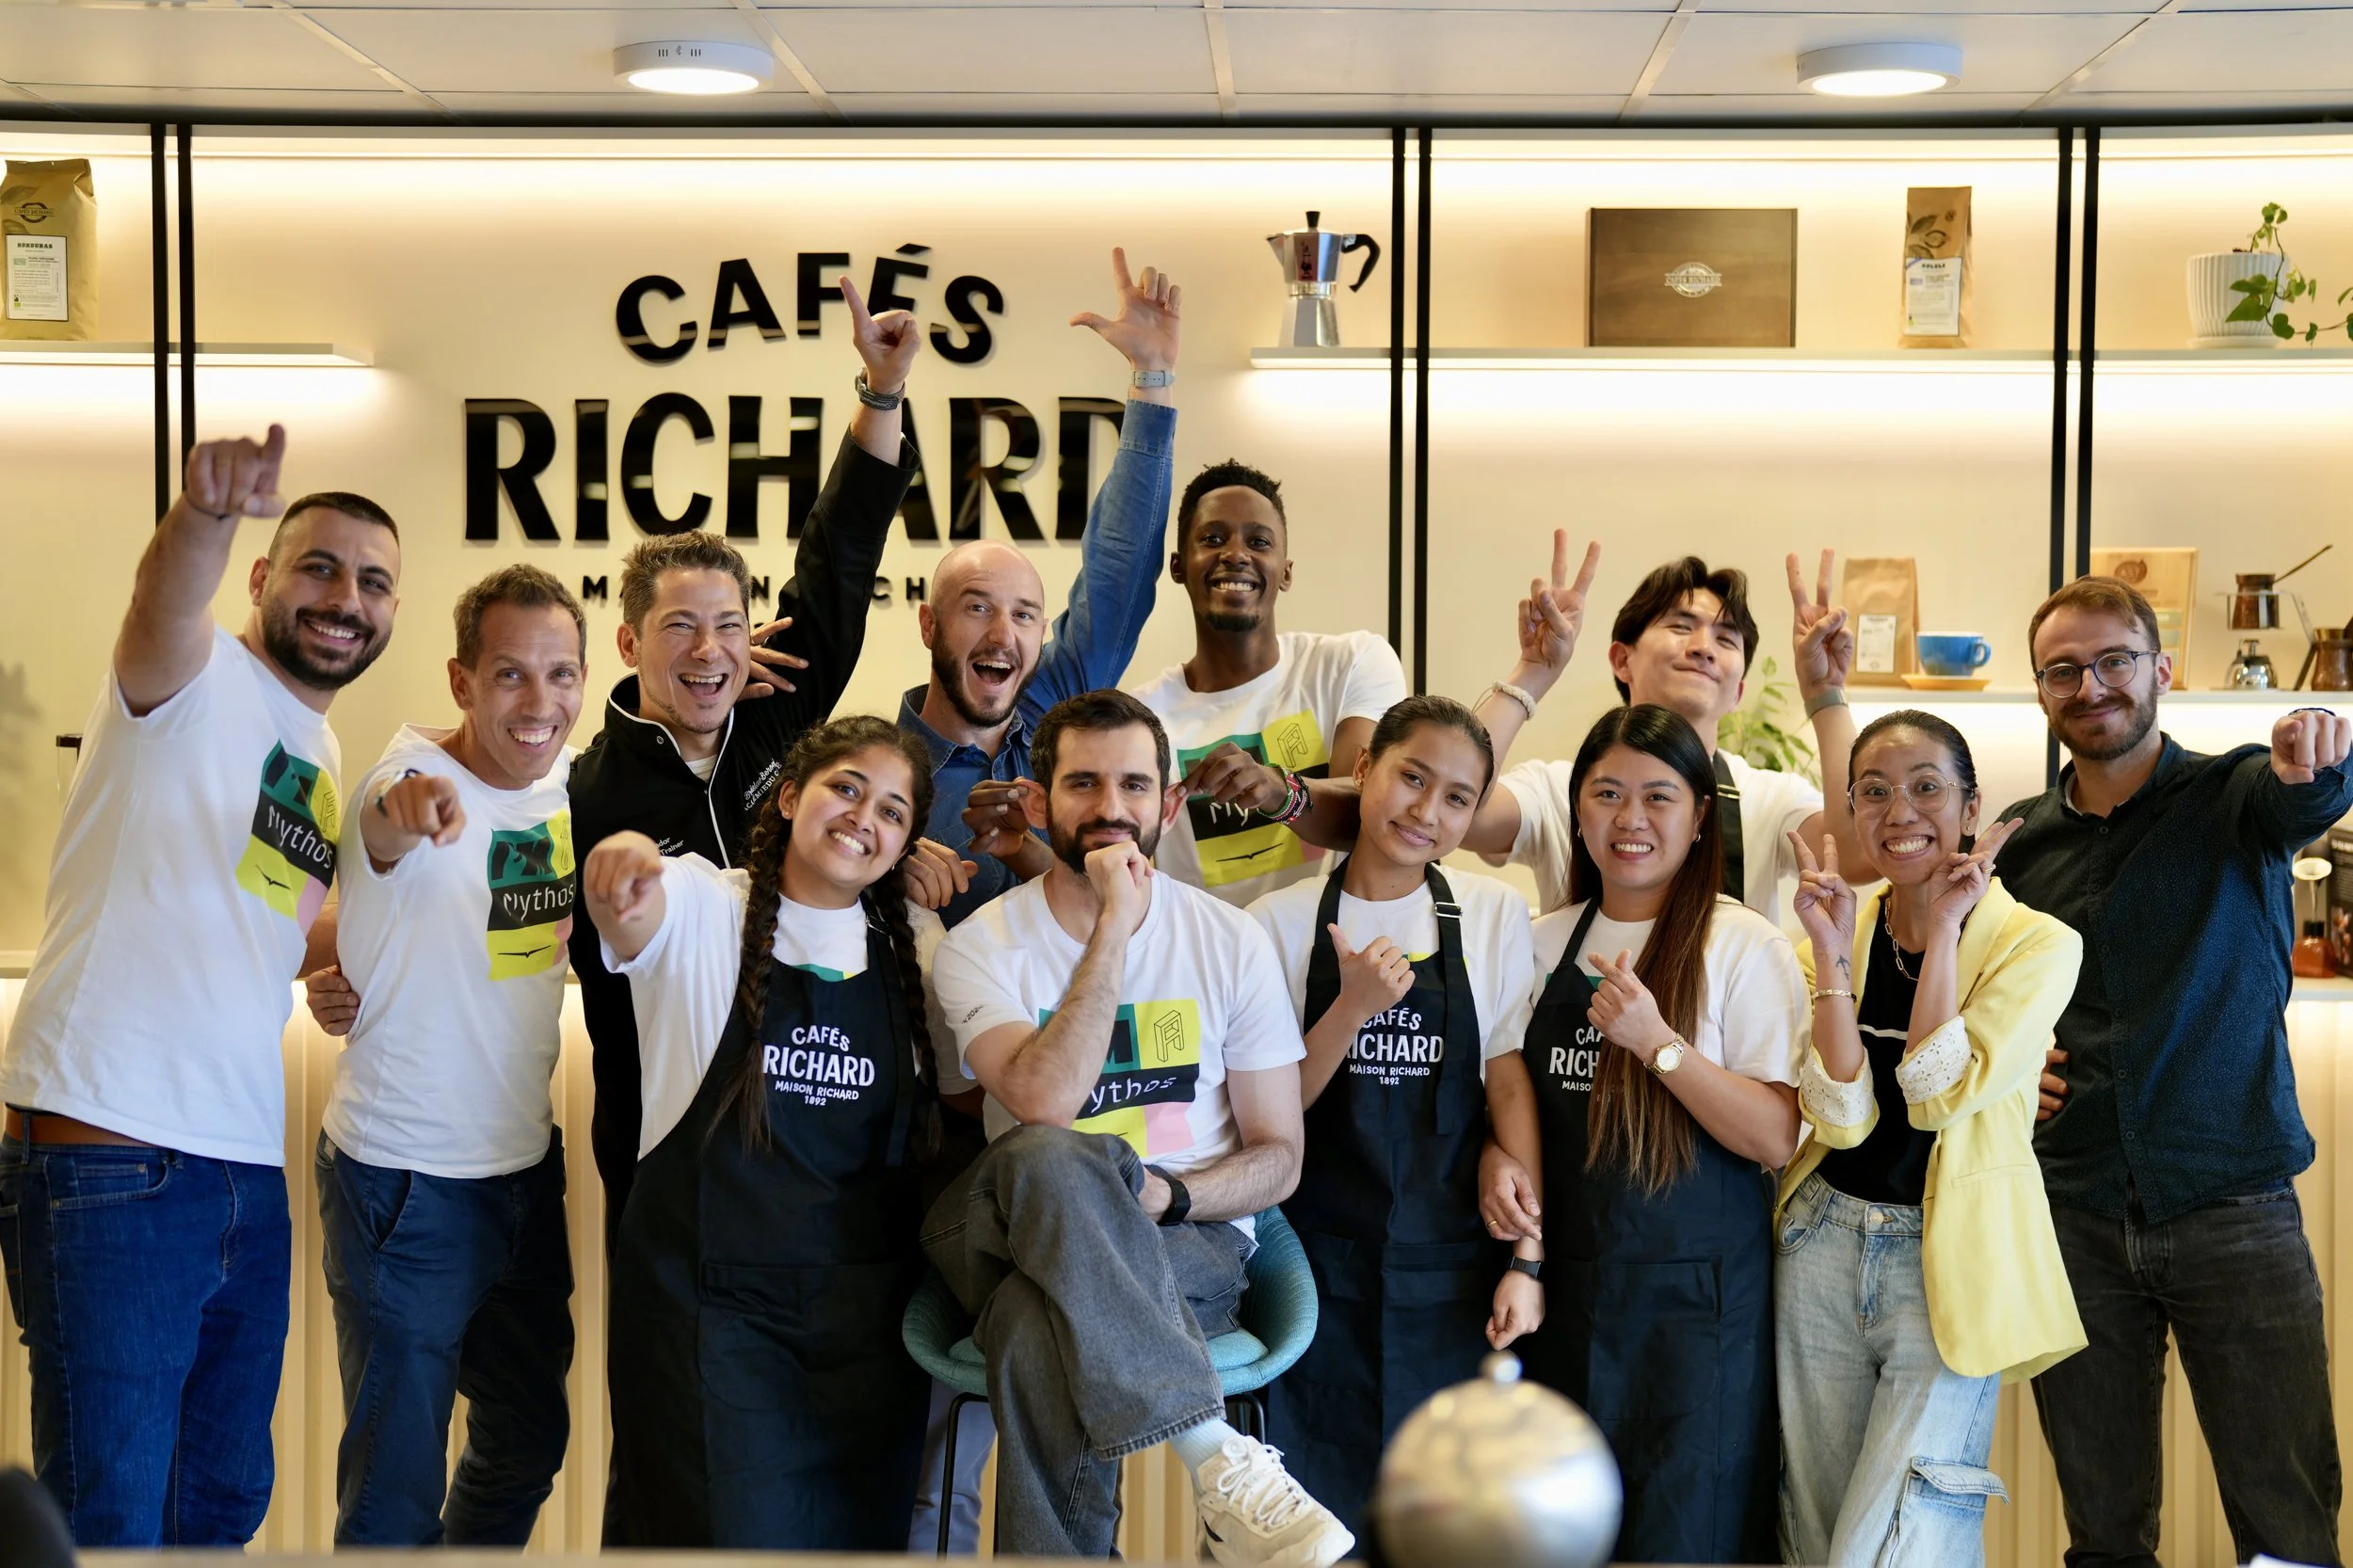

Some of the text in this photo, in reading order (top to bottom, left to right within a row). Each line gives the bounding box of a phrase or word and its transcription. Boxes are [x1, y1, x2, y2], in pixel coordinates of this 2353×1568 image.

[616, 243, 1004, 363] CAFÉS
[267, 805, 333, 870] Mythos
[660, 840, 684, 856] Trainer
[503, 883, 574, 922] Mythos
[791, 1025, 851, 1051] CAFÉS
[1347, 1032, 1445, 1063] ICHARD
[762, 1045, 876, 1086] RICHARD
[1349, 1064, 1431, 1076] MAISON RICHARD
[1548, 1047, 1600, 1078] RICH
[775, 1080, 859, 1100] MAISON RICHARD
[1379, 1076, 1400, 1085] 1892
[1562, 1080, 1593, 1092] MAISO
[804, 1095, 827, 1106] 1892
[1091, 1077, 1177, 1113] ythos
